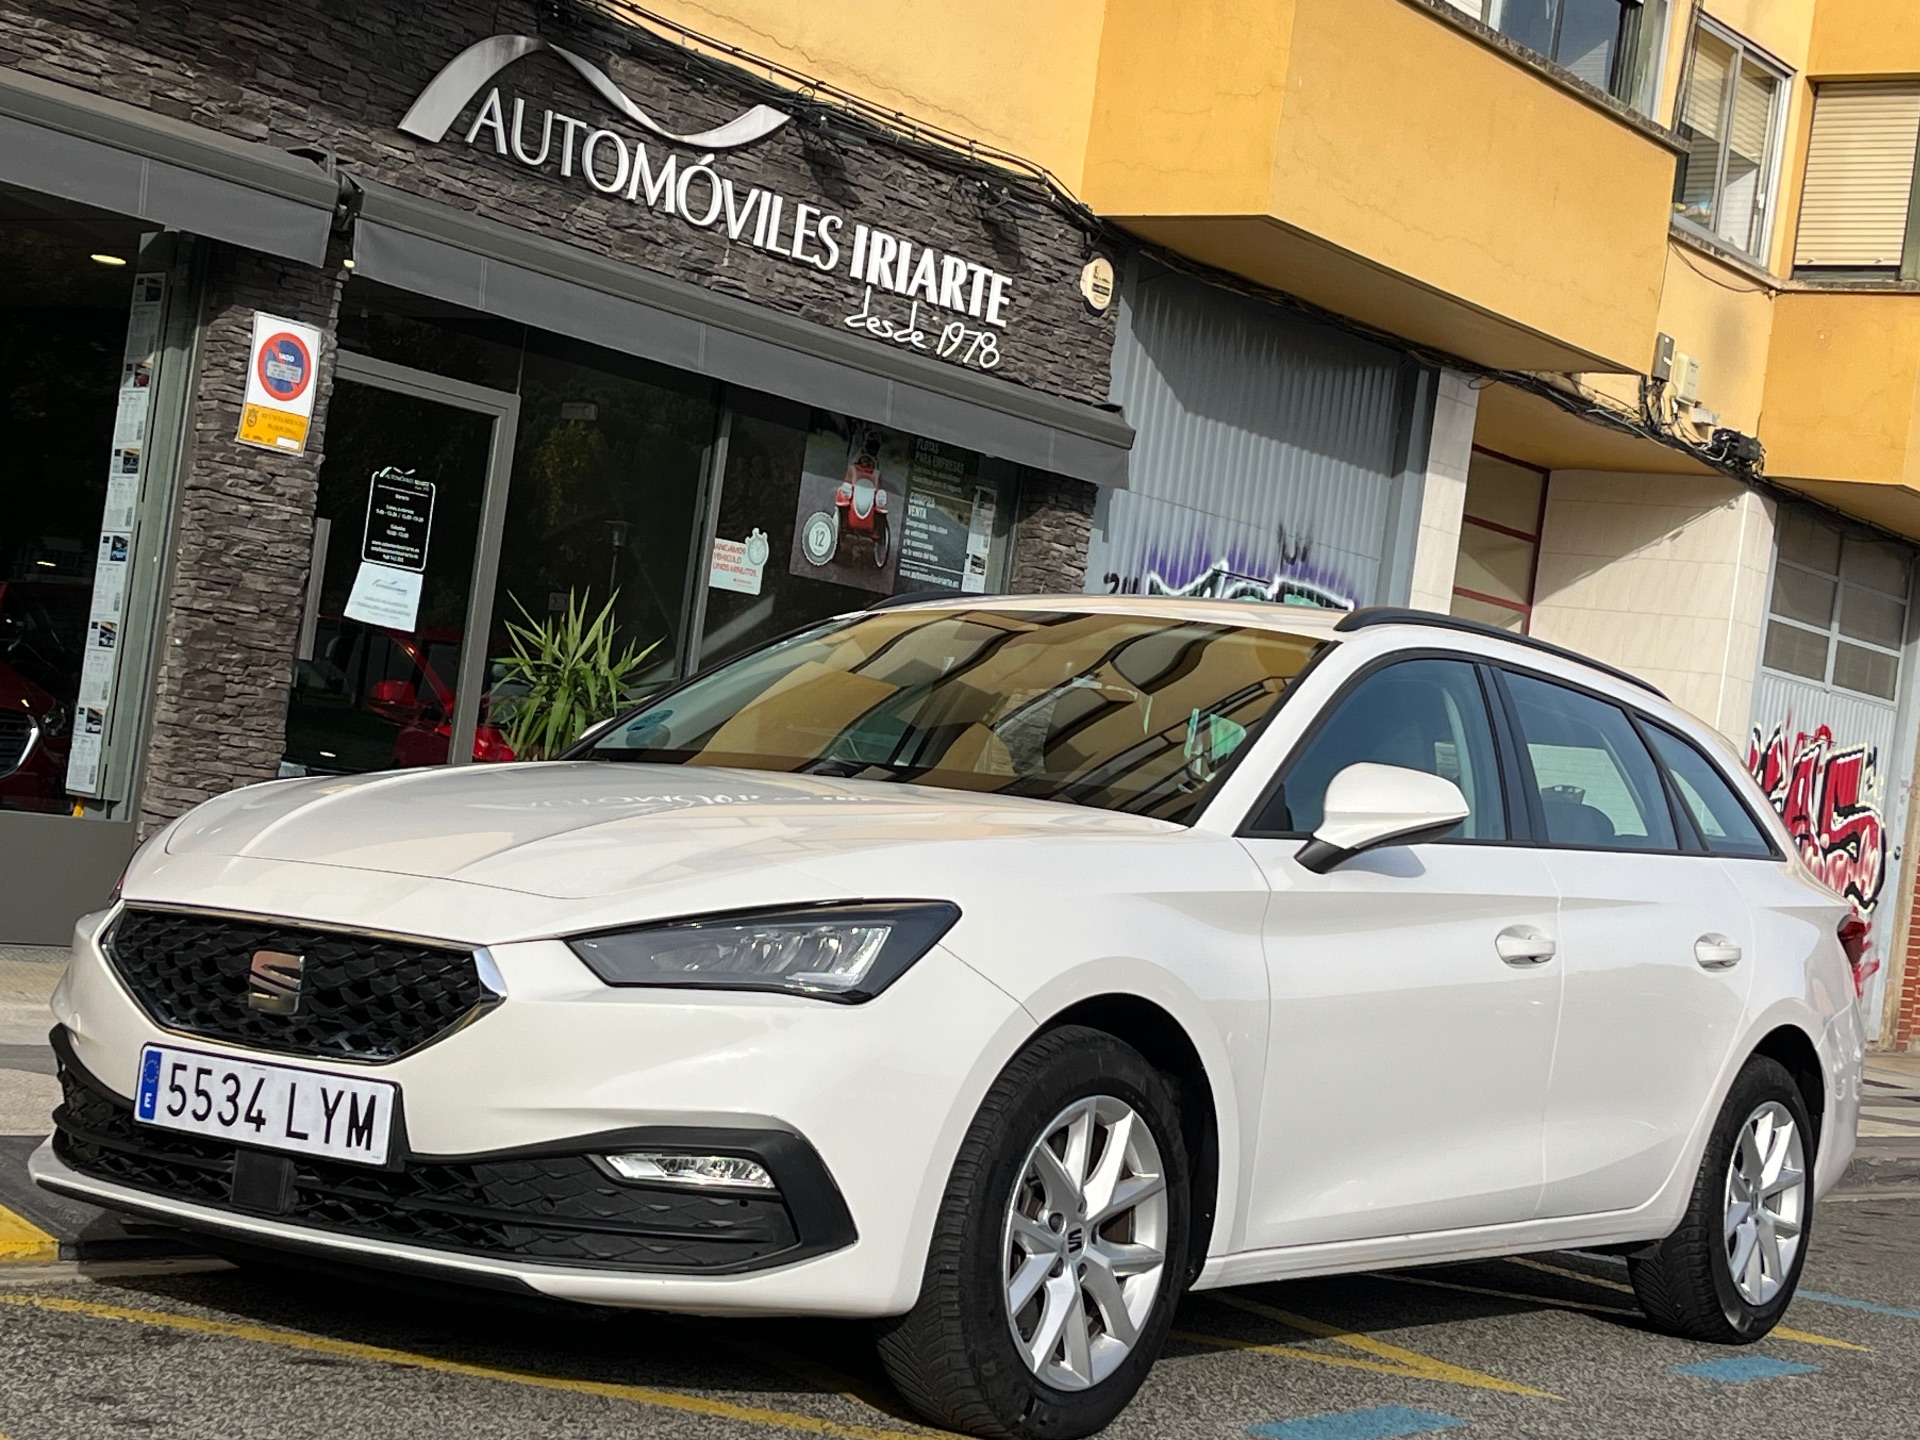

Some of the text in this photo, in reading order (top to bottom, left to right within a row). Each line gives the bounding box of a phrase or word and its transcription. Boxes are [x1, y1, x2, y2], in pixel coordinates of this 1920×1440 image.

[466, 87, 1013, 328] AUTOMÓVILES IRIARTE
[844, 285, 1000, 368] desde 1978
[815, 530, 825, 547] 12
[143, 1063, 378, 1151] E 5534 LYM
